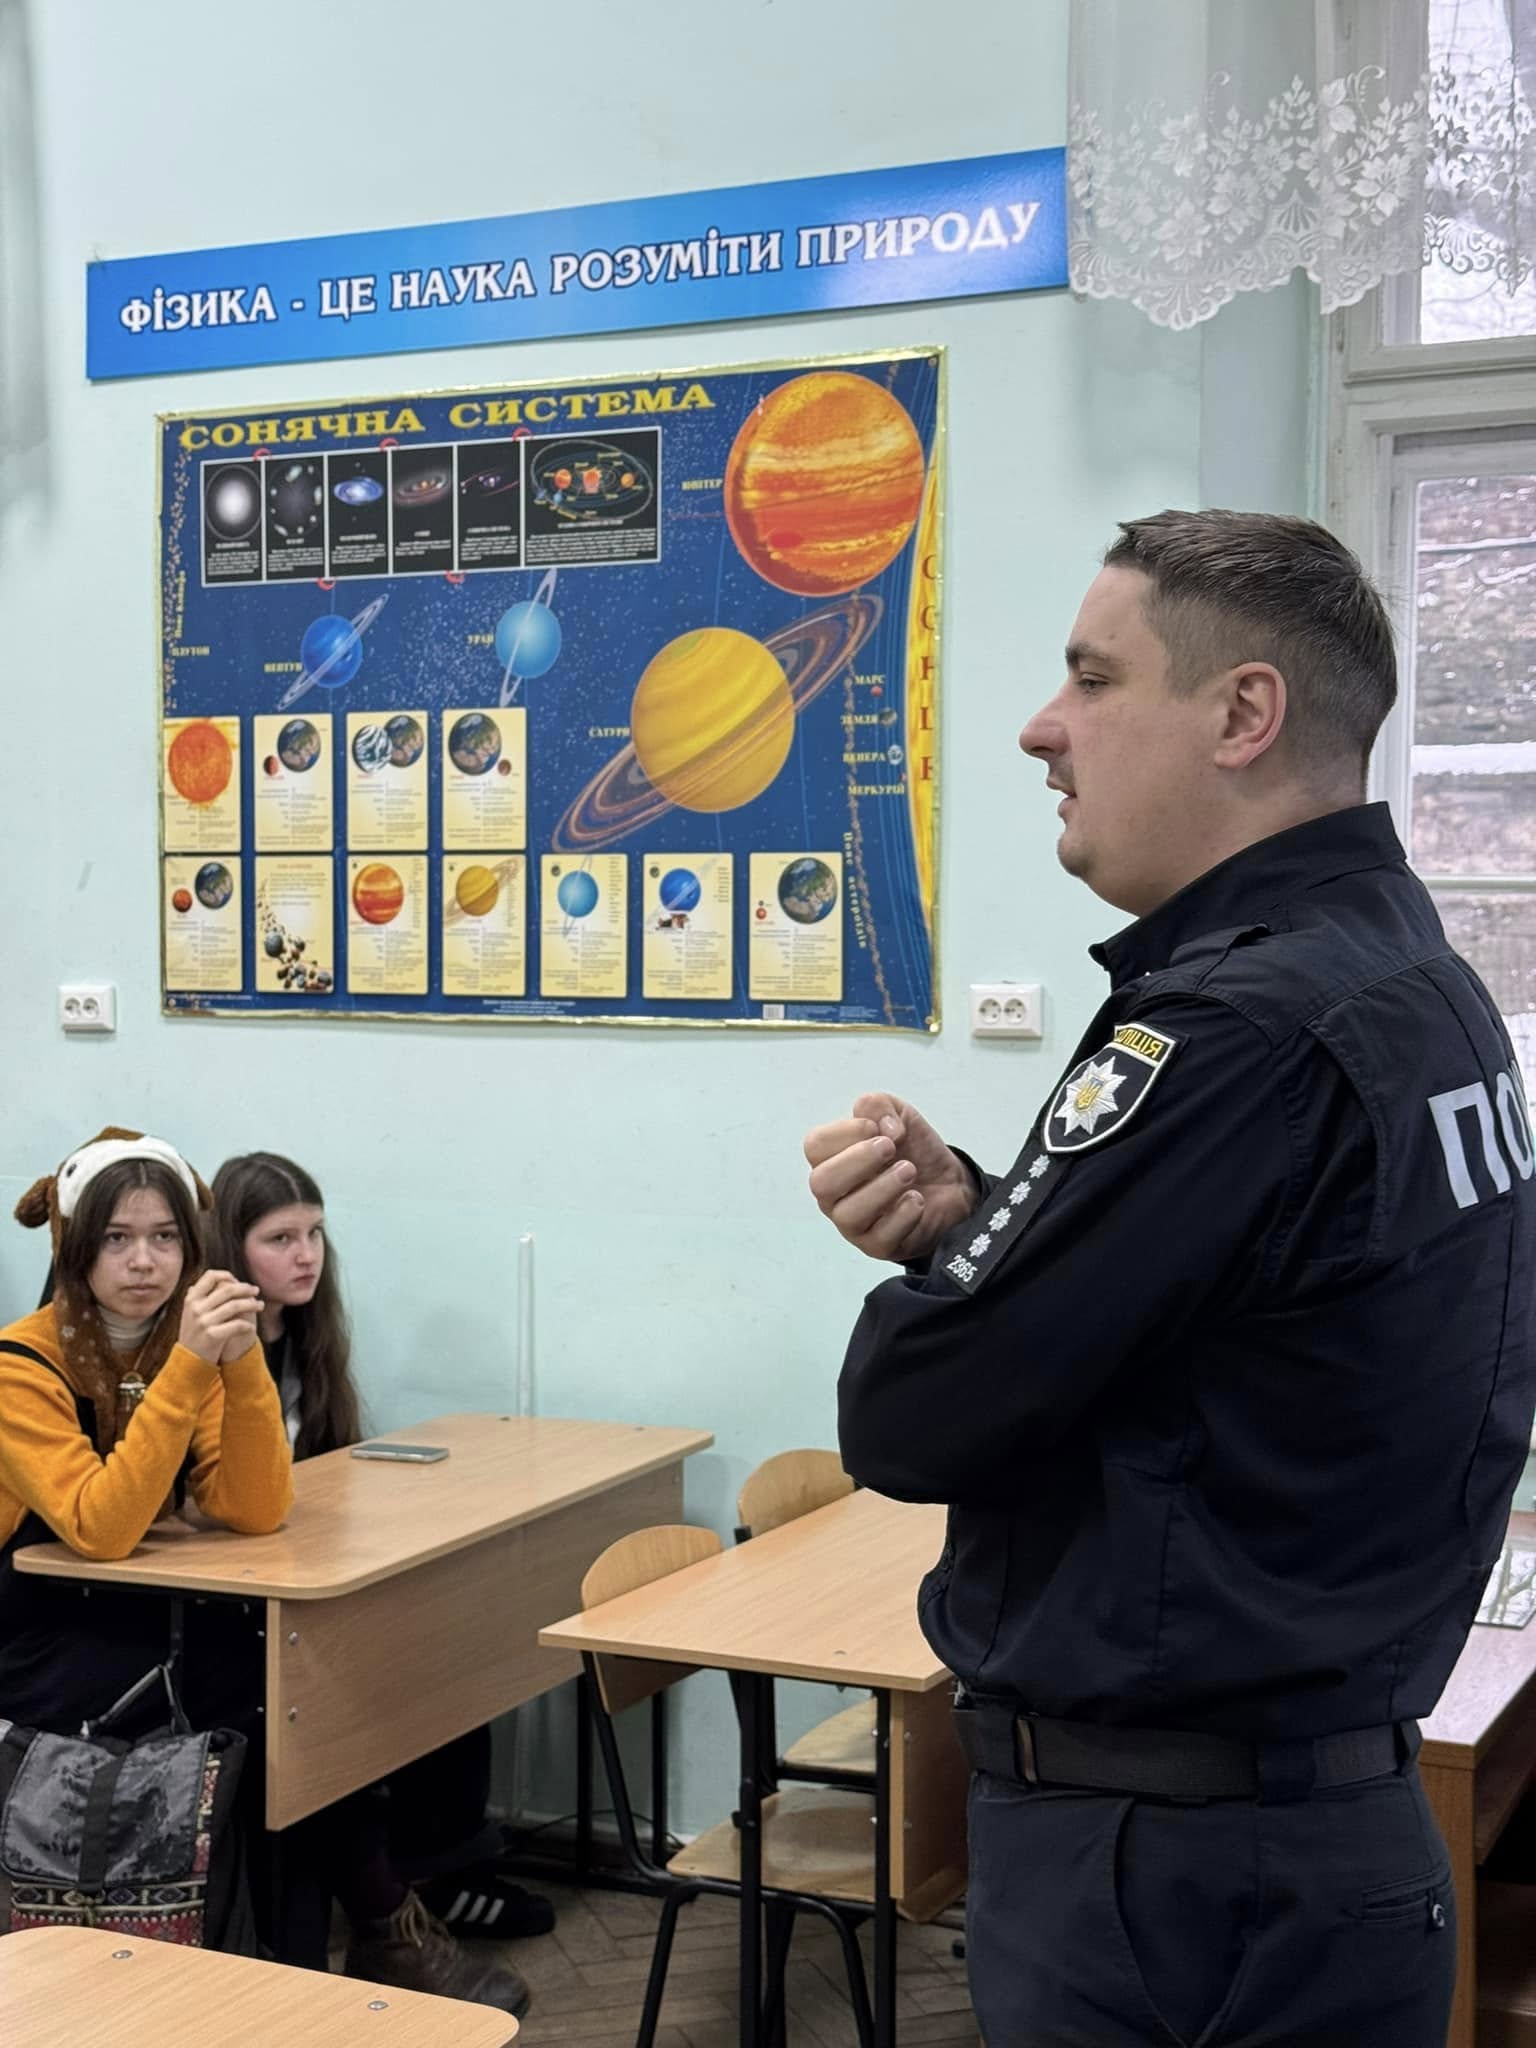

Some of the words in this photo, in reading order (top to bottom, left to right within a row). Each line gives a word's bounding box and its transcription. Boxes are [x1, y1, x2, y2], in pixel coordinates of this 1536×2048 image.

[320, 275, 377, 322] ЦЕ
[390, 258, 536, 312] НАУКА
[797, 202, 1041, 267] ПРИРОДУ
[179, 407, 426, 450] СОНЯЧНА
[448, 383, 716, 429] СИСТЕМА
[855, 674, 886, 686] МАРС
